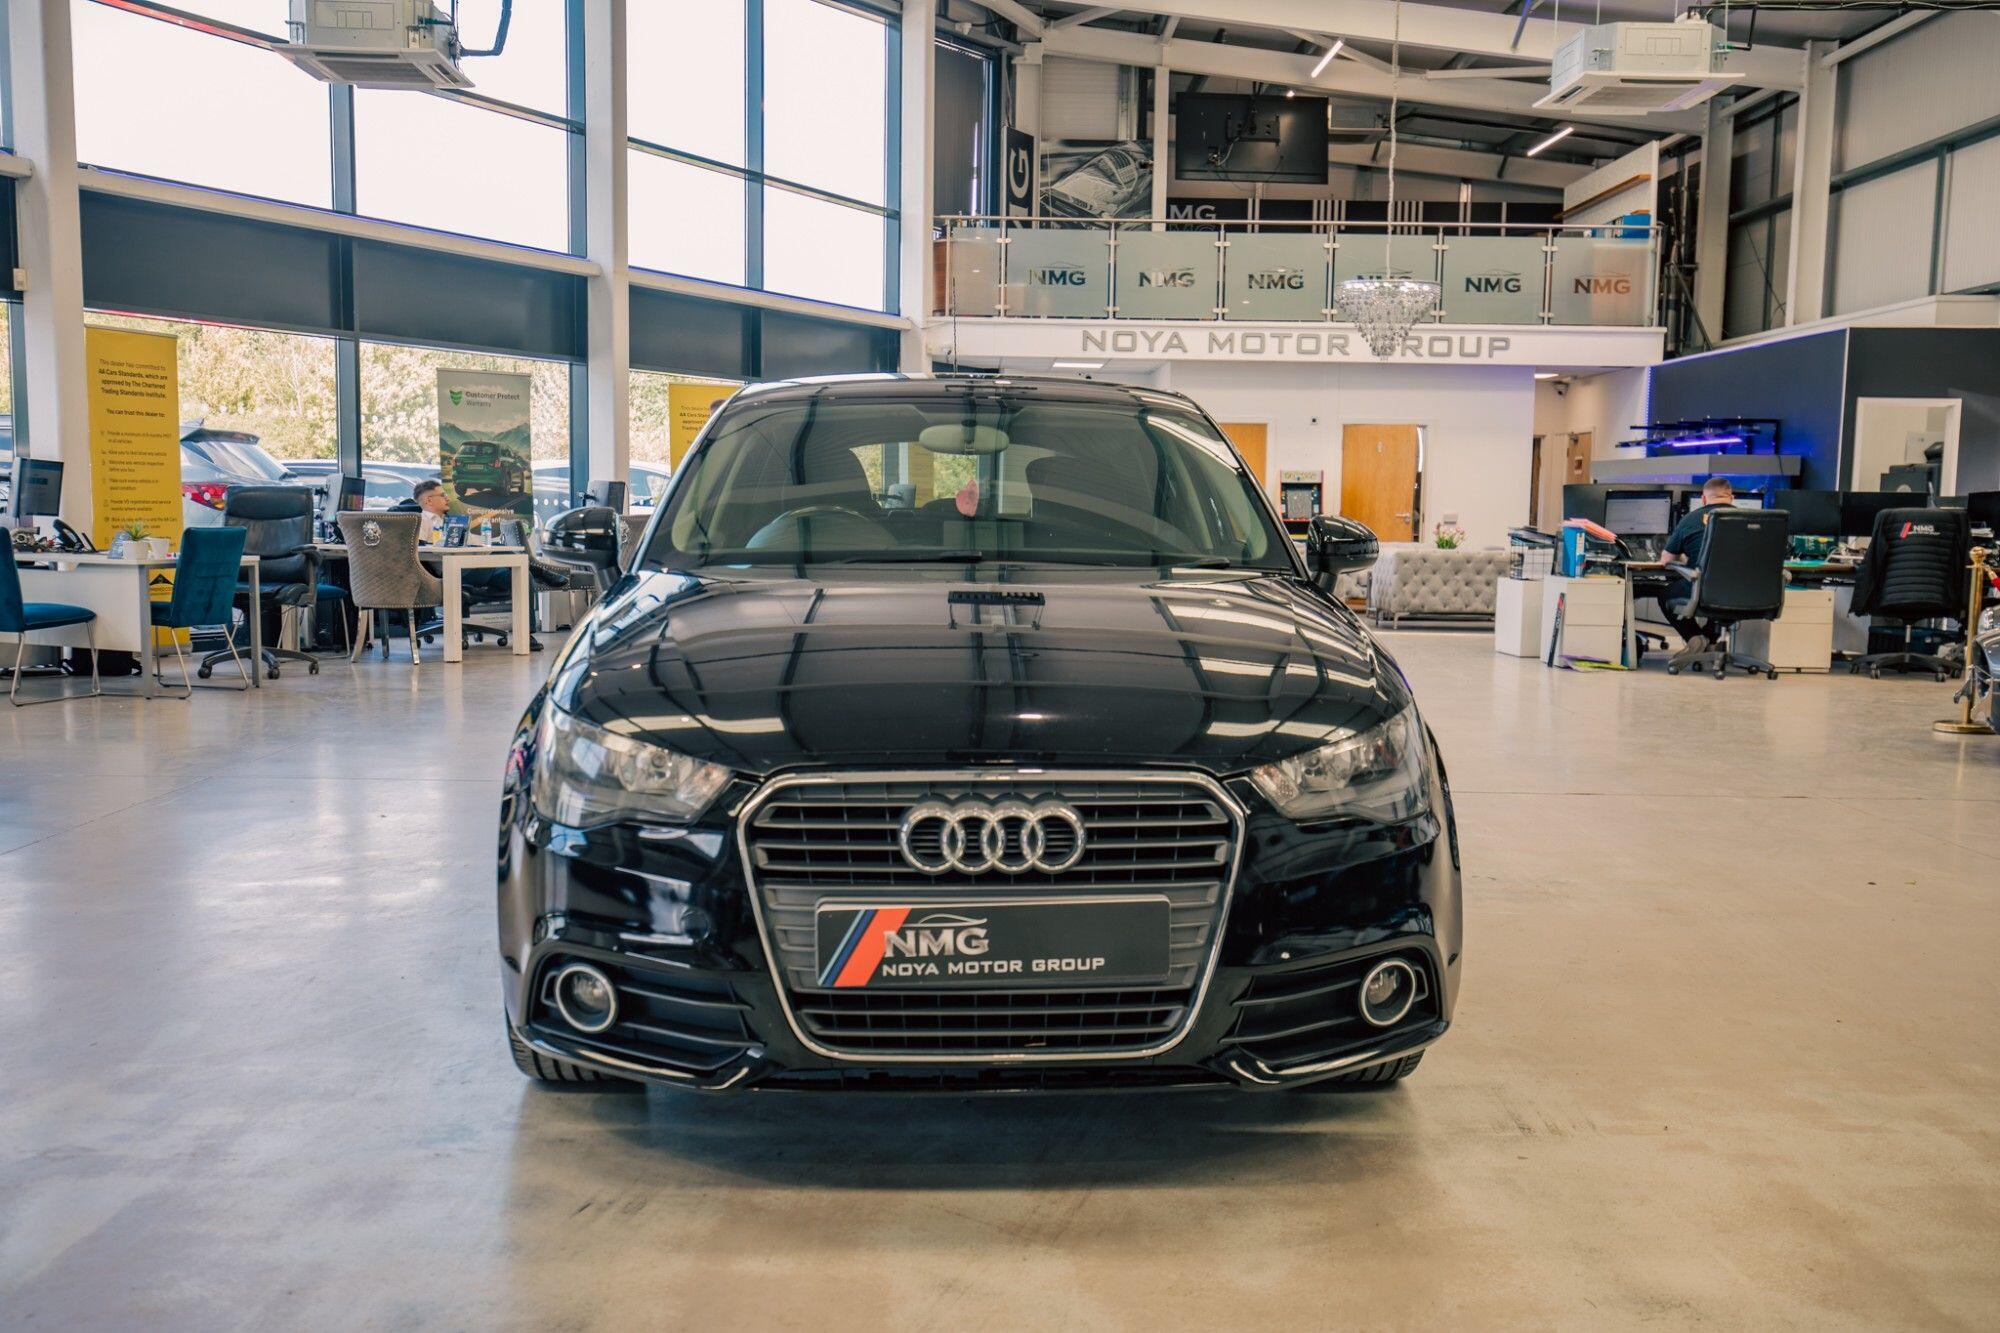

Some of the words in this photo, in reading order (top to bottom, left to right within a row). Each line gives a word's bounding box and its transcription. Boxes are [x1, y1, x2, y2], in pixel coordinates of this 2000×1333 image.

[1029, 268, 1086, 286] NMG
[1139, 272, 1195, 288] NMG
[1248, 274, 1304, 290] NMG
[1465, 277, 1522, 293] NMG
[1574, 278, 1631, 294] NMG
[1082, 330, 1188, 353] NOYA
[1208, 331, 1350, 356] MOTOR
[1371, 334, 1510, 358] ROUP
[465, 390, 496, 398] Customer
[498, 392, 520, 400] Protect
[883, 927, 990, 958] NMG
[882, 963, 939, 976] NOYA
[948, 960, 1023, 974] MOTOR
[1032, 957, 1105, 972] GROUP
